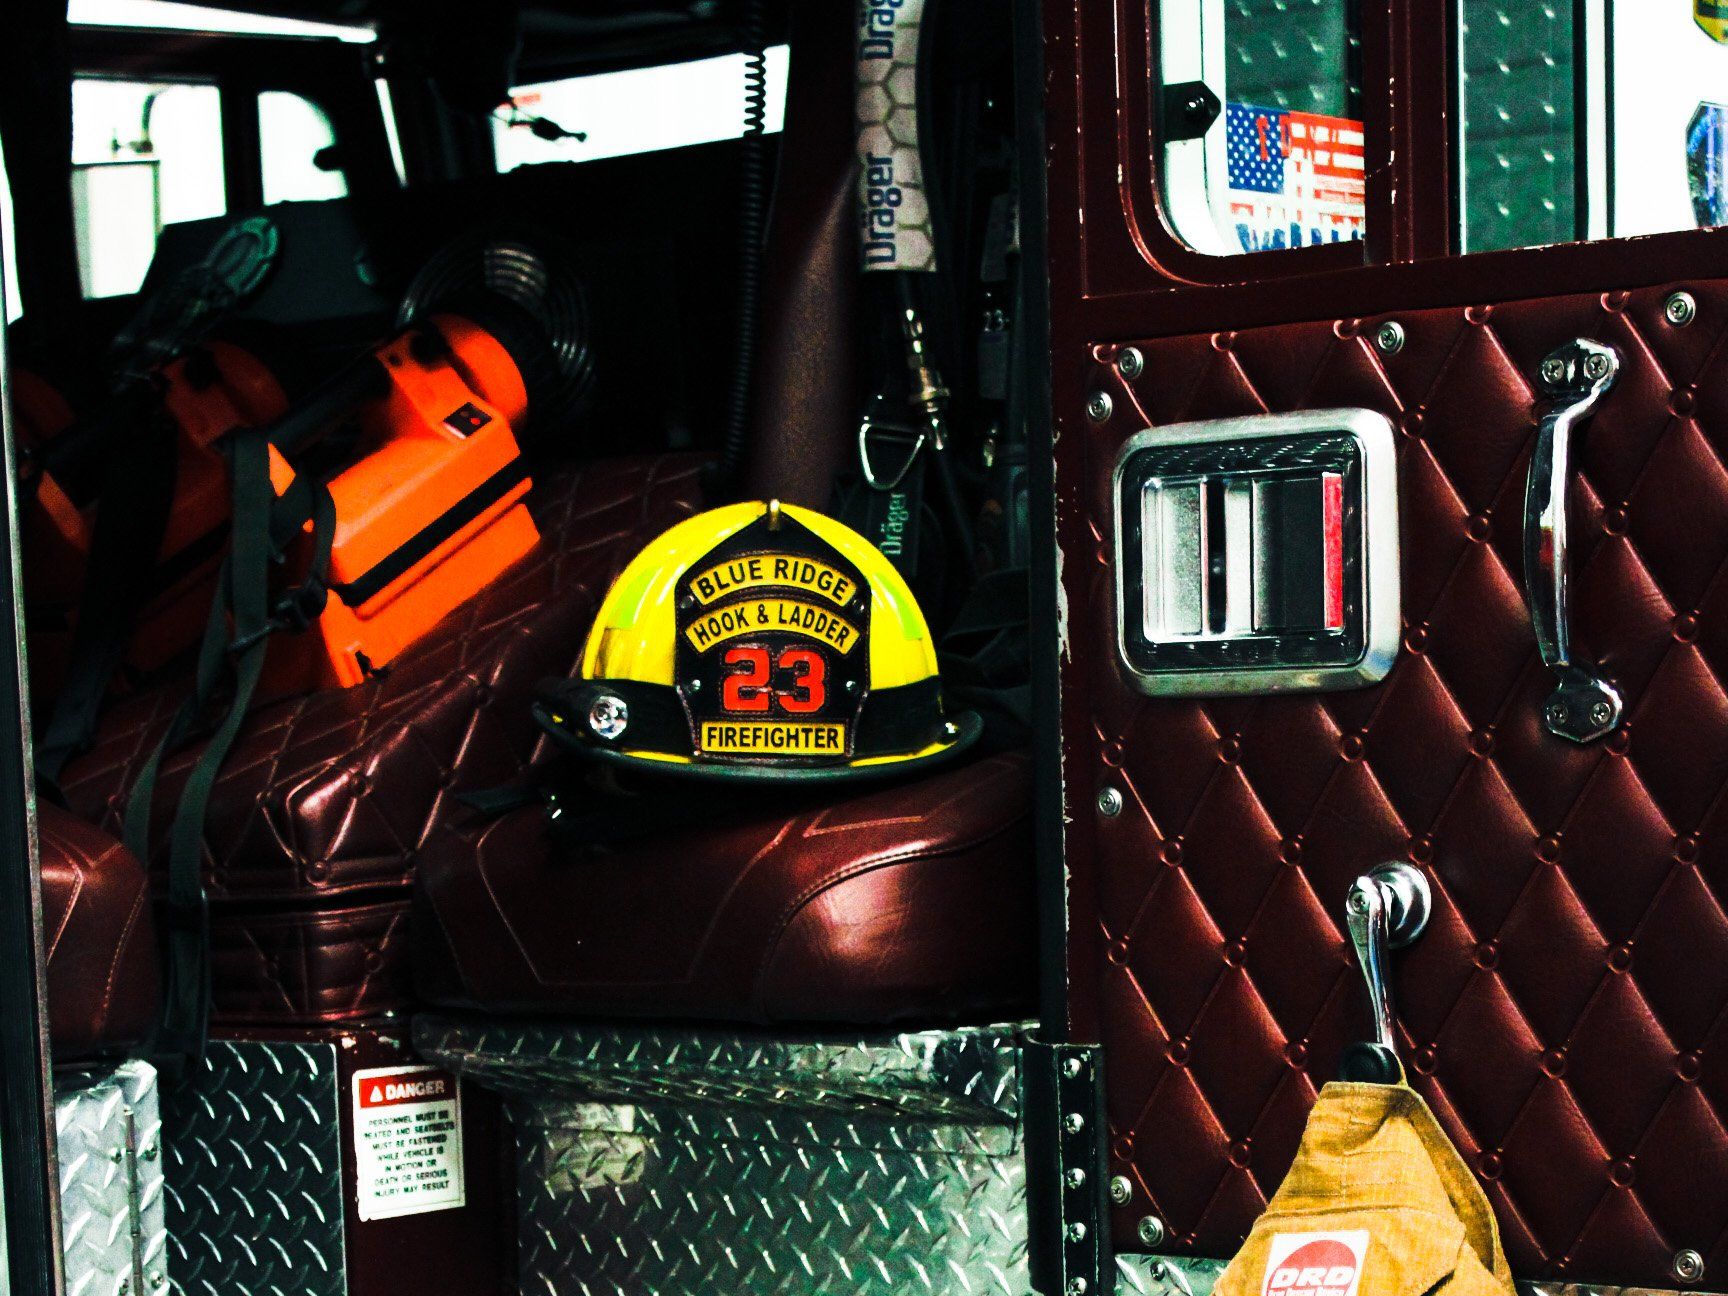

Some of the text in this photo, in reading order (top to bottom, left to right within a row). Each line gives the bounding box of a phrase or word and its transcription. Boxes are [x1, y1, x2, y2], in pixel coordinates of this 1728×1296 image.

[862, 152, 902, 264] Dräger
[879, 493, 909, 555] Dräger
[696, 558, 849, 601] BLUE RIDGE
[693, 603, 851, 647] HOOK & LADDER
[723, 647, 825, 713] 23
[707, 726, 839, 749] FIREFIGHTER
[385, 1080, 445, 1100] DANGER
[368, 1115, 413, 1126] PERSONNEL
[415, 1111, 436, 1121] MUST
[363, 1129, 392, 1139] SEATED
[396, 1127, 411, 1135] AND
[372, 1133, 448, 1149] MUST BE FASTENED
[377, 1152, 399, 1161] WHILE
[403, 1147, 434, 1157] VEHICLE
[395, 1160, 423, 1170] MOTION
[426, 1159, 437, 1167] OR
[374, 1176, 398, 1186] DEATH
[415, 1168, 448, 1179] SERIOUS
[374, 1180, 450, 1197] INJURY MAY RESULT
[1270, 1265, 1355, 1288] DRD
